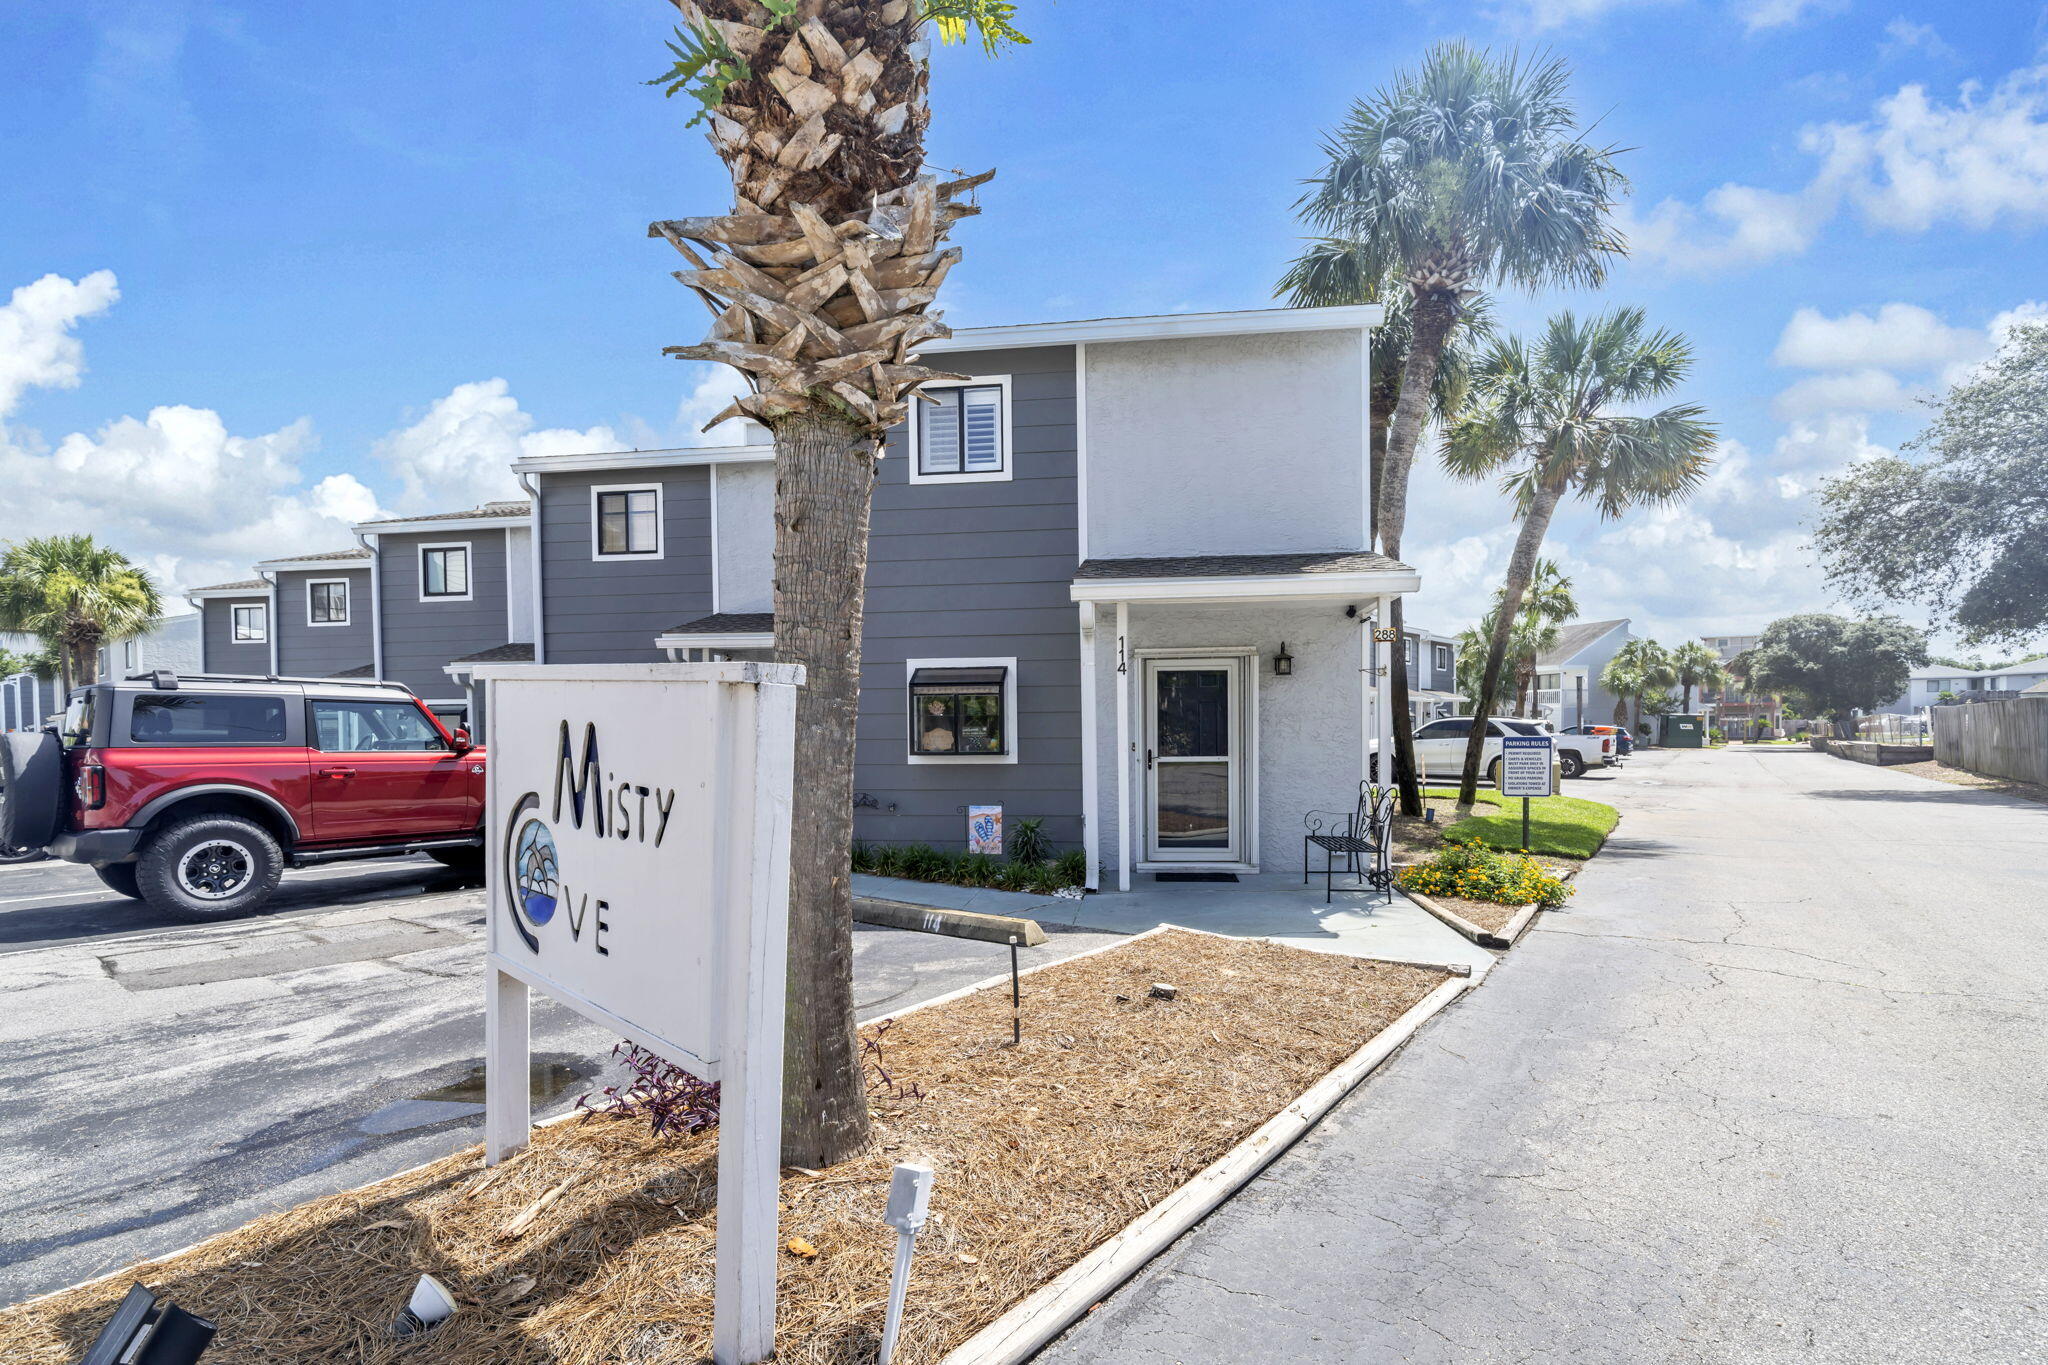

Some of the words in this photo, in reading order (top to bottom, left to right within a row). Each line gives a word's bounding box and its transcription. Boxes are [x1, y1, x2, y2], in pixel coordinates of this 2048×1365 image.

[1375, 629, 1396, 640] 288
[1117, 635, 1127, 675] 114
[923, 912, 943, 933] 114
